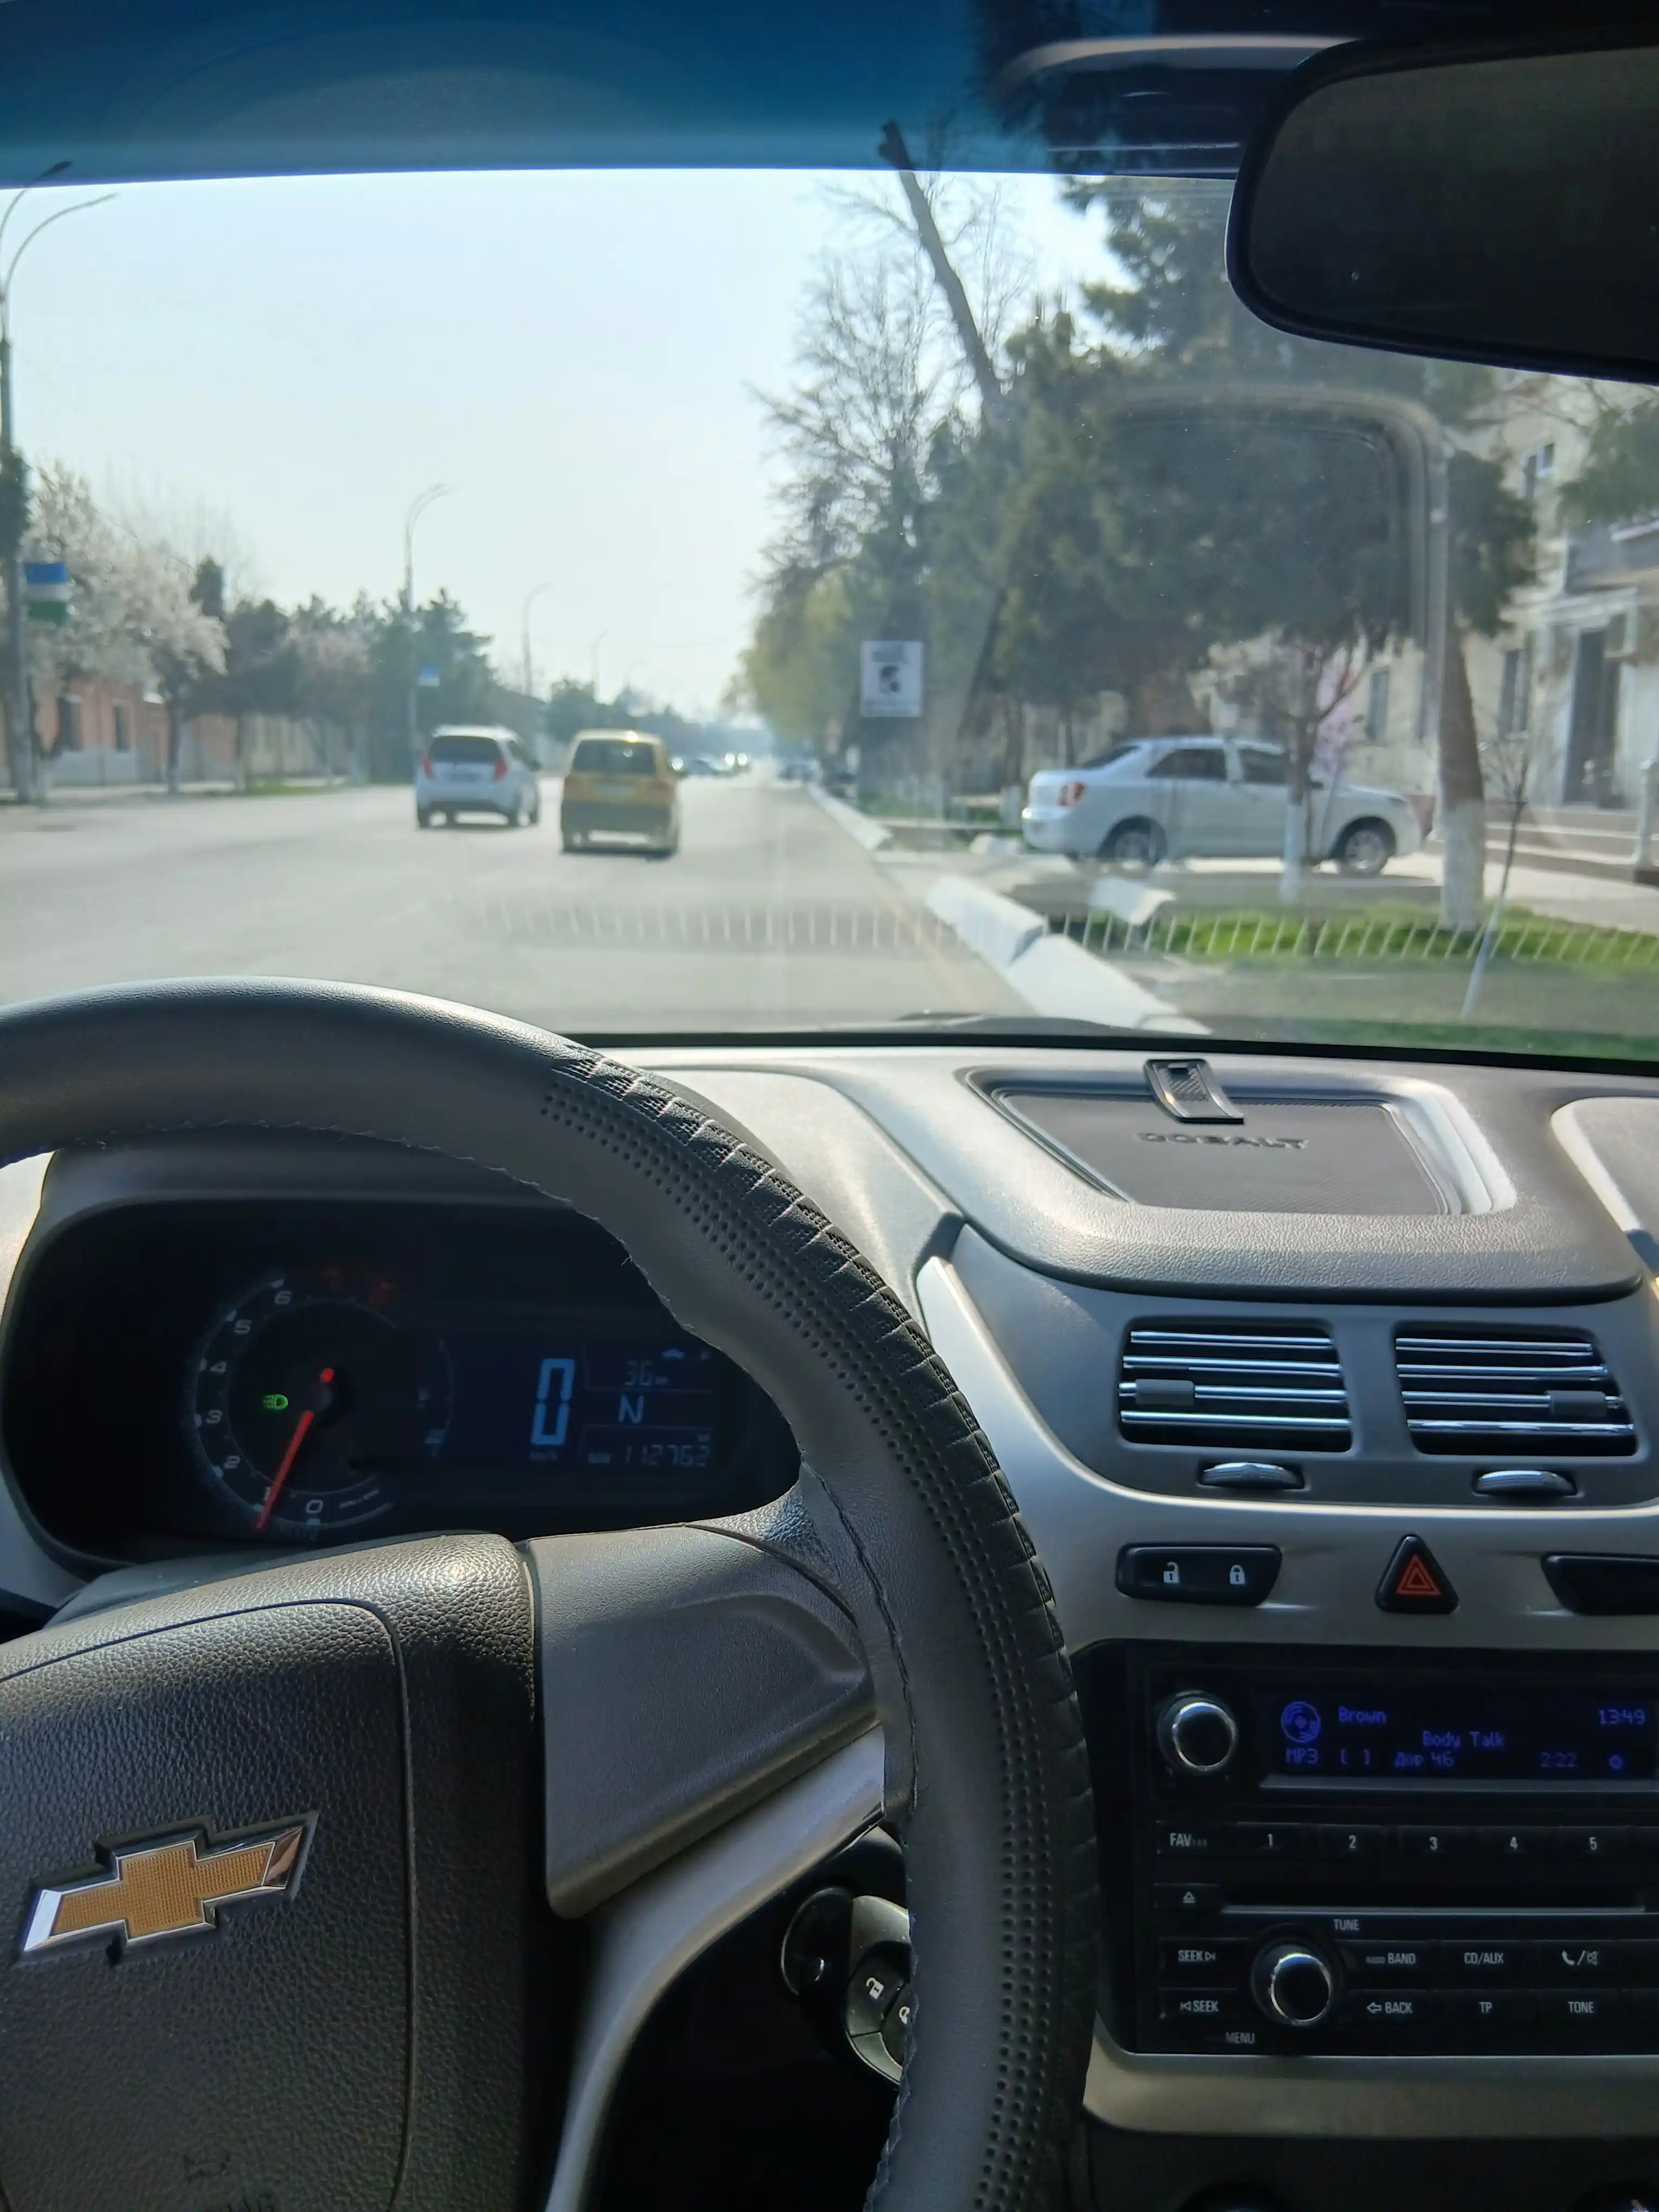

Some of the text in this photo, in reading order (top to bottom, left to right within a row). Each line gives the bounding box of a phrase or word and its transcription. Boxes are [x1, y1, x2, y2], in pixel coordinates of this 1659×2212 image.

[274, 1291, 292, 1304] 6
[234, 1320, 252, 1335] 5
[210, 1361, 227, 1374] 4
[531, 1358, 575, 1444] 0
[618, 1395, 645, 1423] N
[206, 1410, 222, 1423] 3
[223, 1455, 241, 1469] 2
[306, 1499, 323, 1514] 0
[1339, 1706, 1386, 1724] Brown
[1423, 1731, 1505, 1748] Body Talk
[1286, 1748, 1318, 1764] MP3
[1170, 1832, 1192, 1847] FAV
[1267, 1834, 1273, 1847] 1
[1349, 1835, 1356, 1849] 2
[1430, 1836, 1438, 1850] 3
[1510, 1836, 1518, 1850] 4
[1589, 1837, 1597, 1850] 5
[1333, 1919, 1359, 1931] TUNE
[1178, 1950, 1203, 1962] SEEK
[1388, 1952, 1416, 1964] BAND
[1464, 1952, 1504, 1964] CD/AUX
[1193, 2001, 1219, 2012] SEEK
[1385, 2002, 1413, 2014] BACK
[1479, 2002, 1492, 2013] TP
[1568, 2002, 1594, 2014] TONE
[1225, 2032, 1255, 2044] MENU
